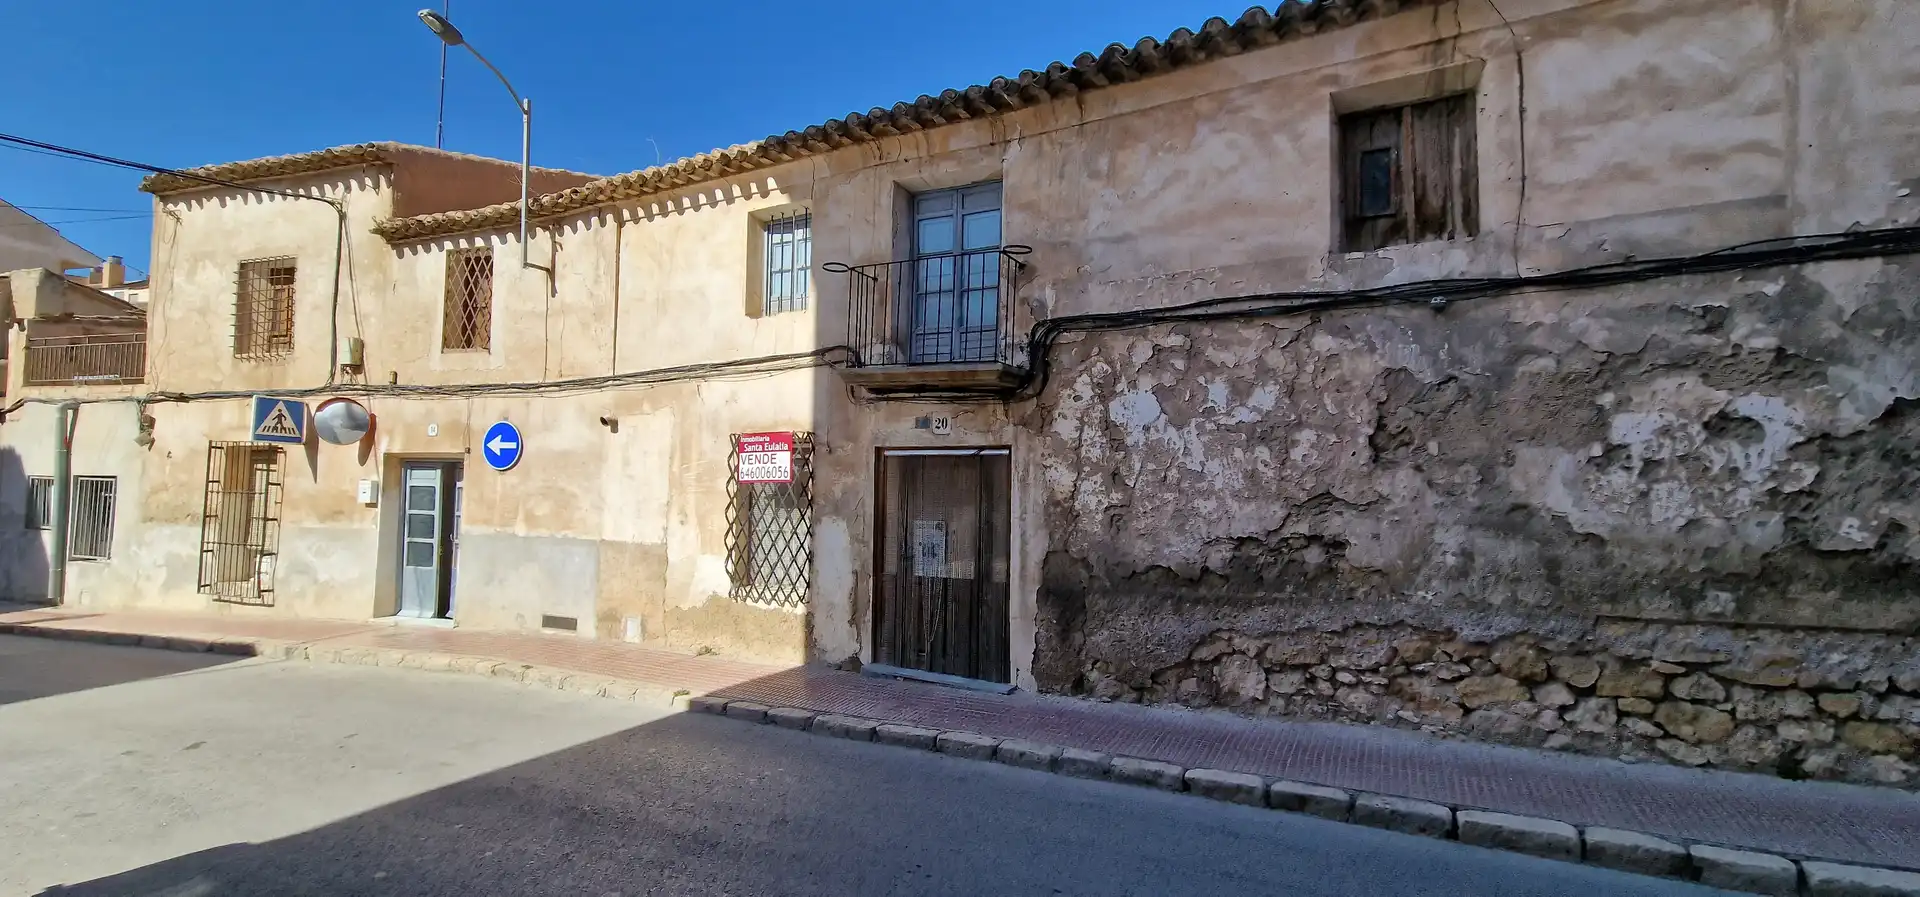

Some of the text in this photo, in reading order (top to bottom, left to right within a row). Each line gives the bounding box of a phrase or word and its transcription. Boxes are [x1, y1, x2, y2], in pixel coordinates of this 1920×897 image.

[935, 417, 948, 429] 20
[744, 442, 788, 452] Santa Eulalia
[740, 453, 777, 465] VENDE
[740, 466, 789, 479] 646006056
